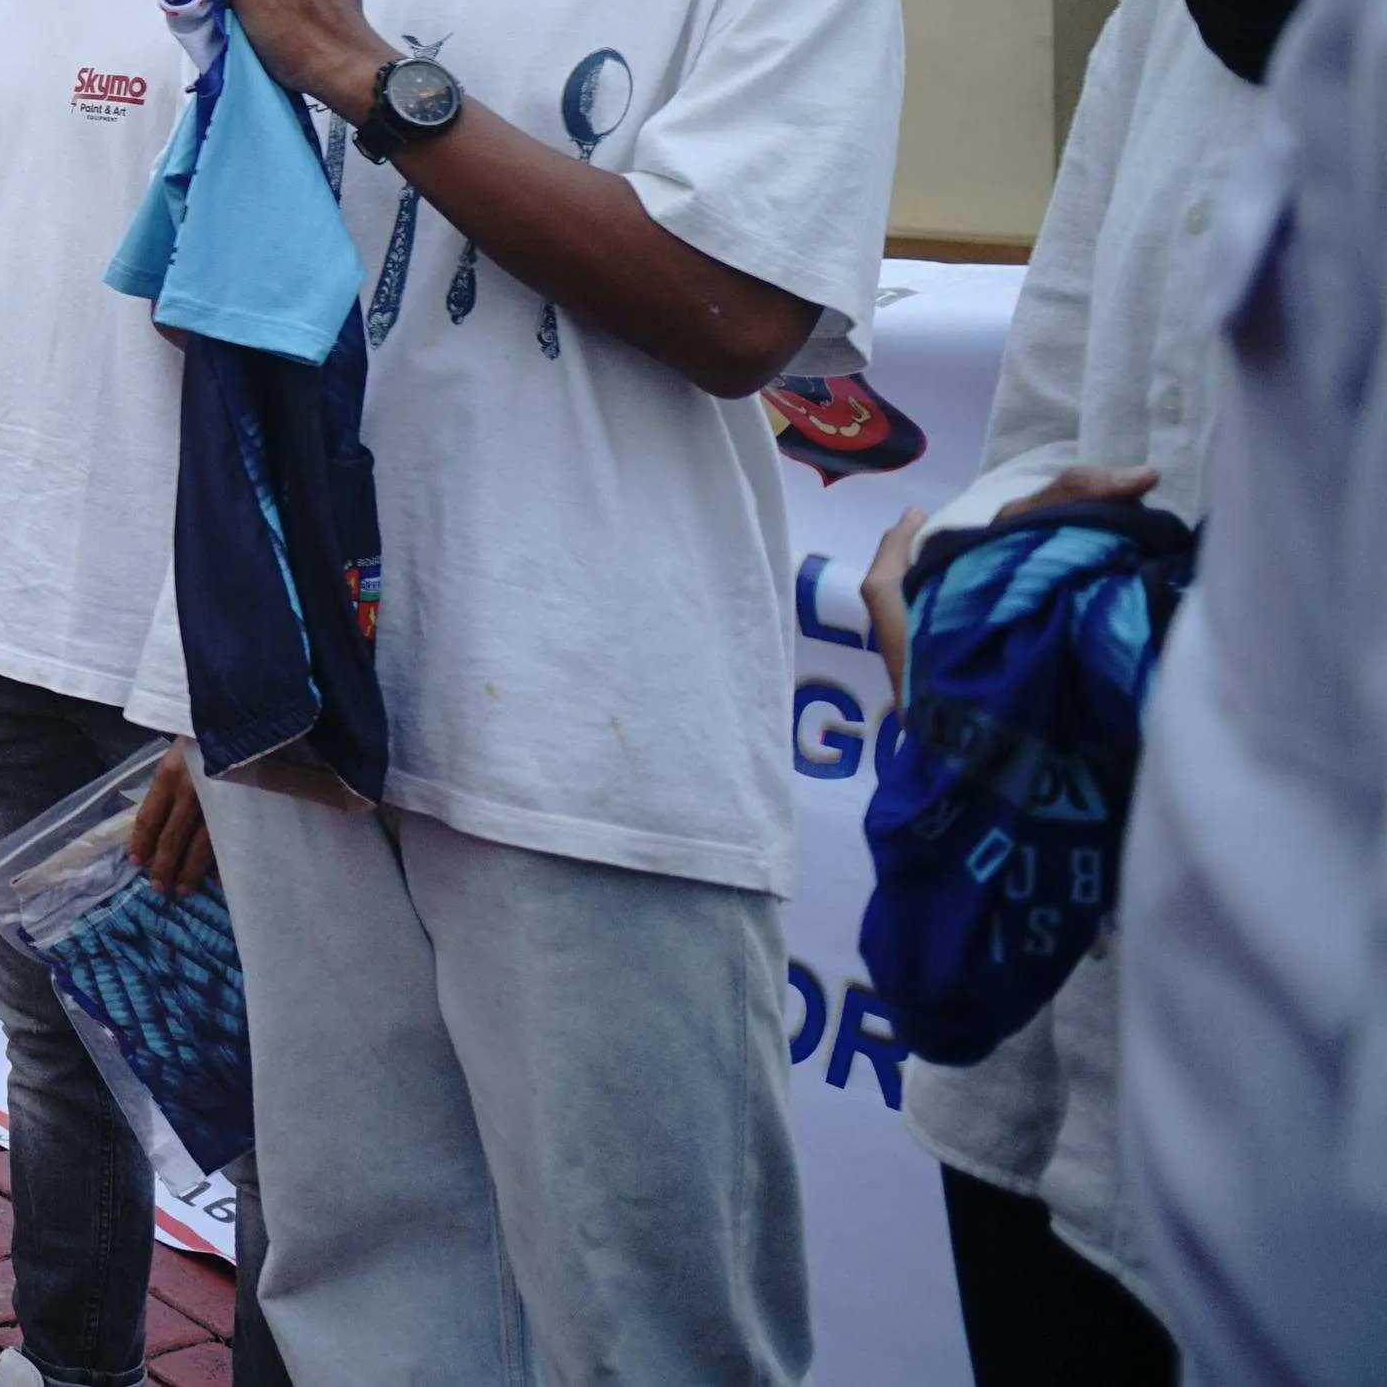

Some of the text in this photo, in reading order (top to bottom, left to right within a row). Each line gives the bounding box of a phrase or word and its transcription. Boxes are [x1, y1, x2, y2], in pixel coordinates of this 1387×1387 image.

[73, 67, 148, 99] Skymo
[79, 103, 103, 114] Paint
[113, 106, 127, 117] Art
